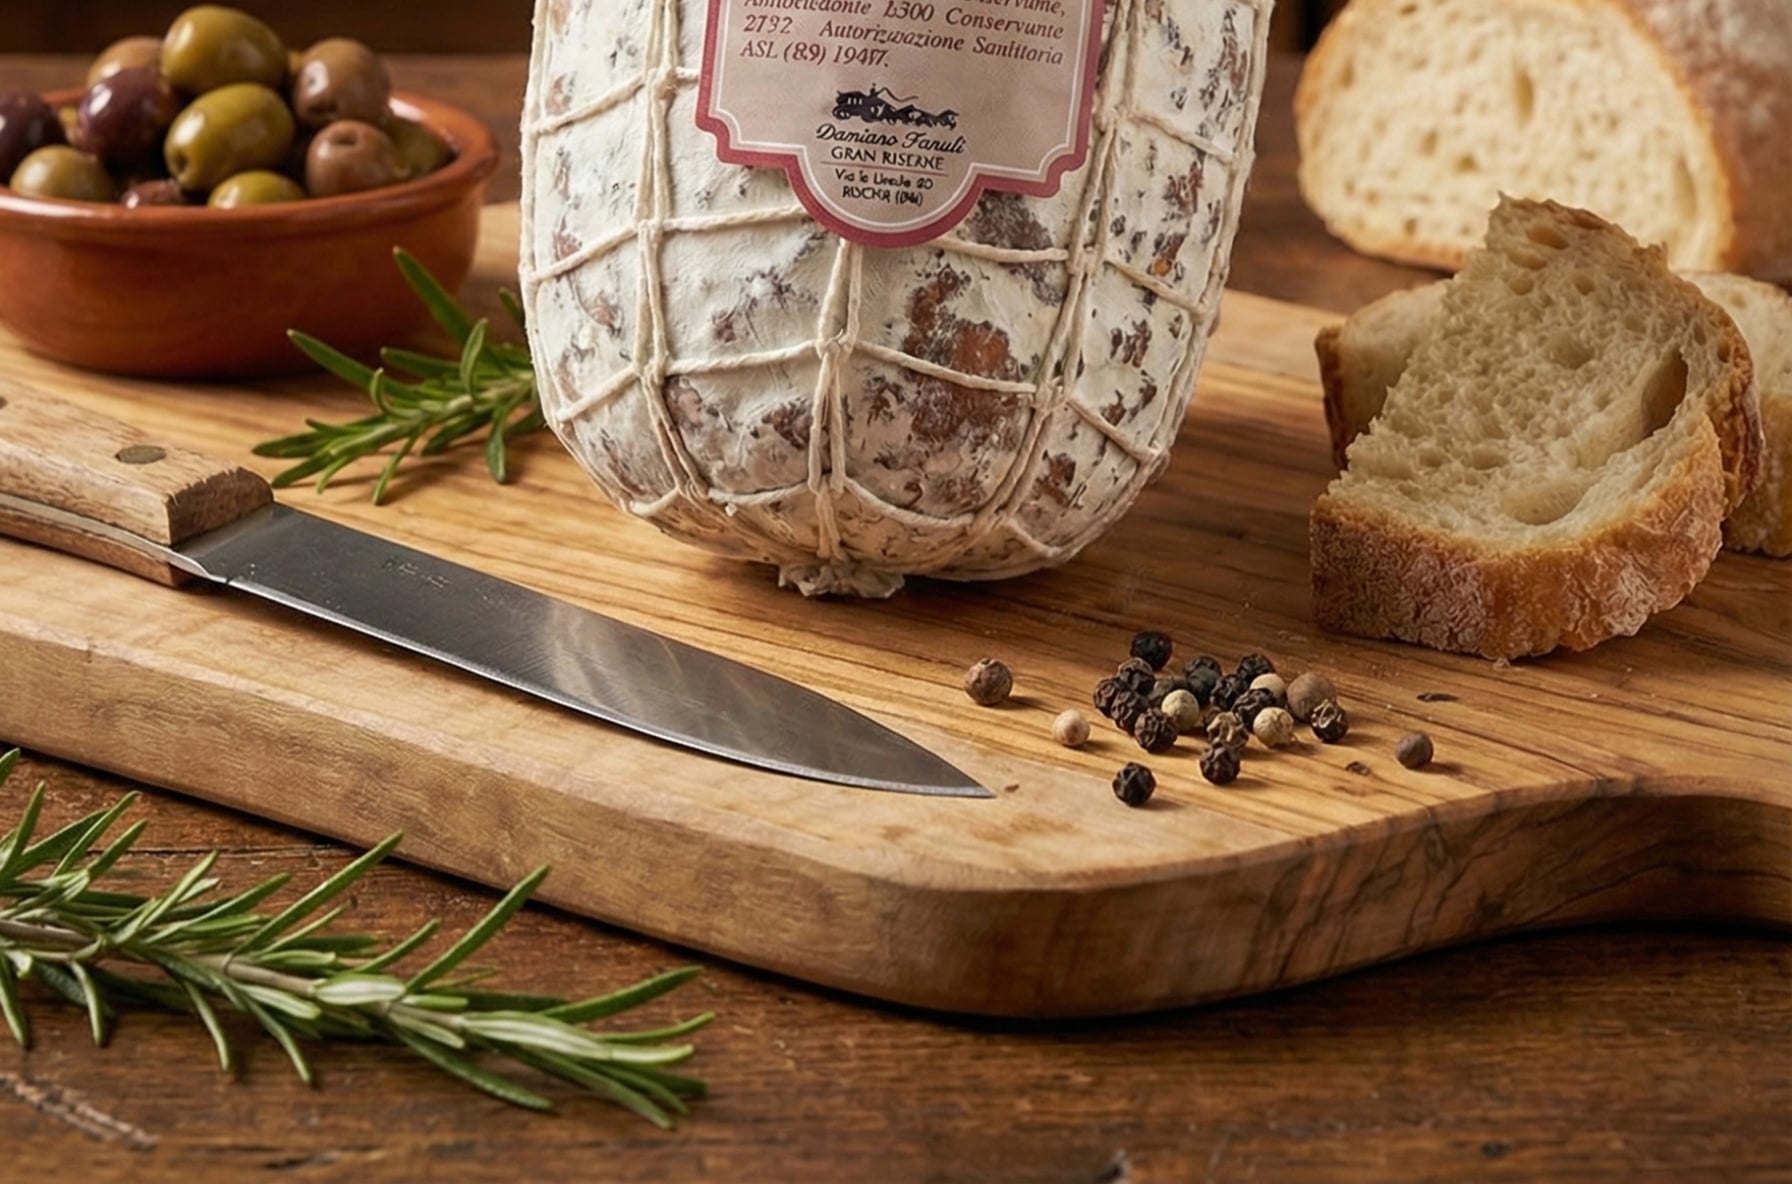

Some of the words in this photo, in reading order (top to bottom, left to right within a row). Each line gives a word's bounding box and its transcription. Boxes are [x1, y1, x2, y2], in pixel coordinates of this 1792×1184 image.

[740, 40, 778, 59] ASL
[816, 123, 899, 147] Damiano
[901, 131, 967, 155] Fanuli
[831, 146, 876, 163] GRAN
